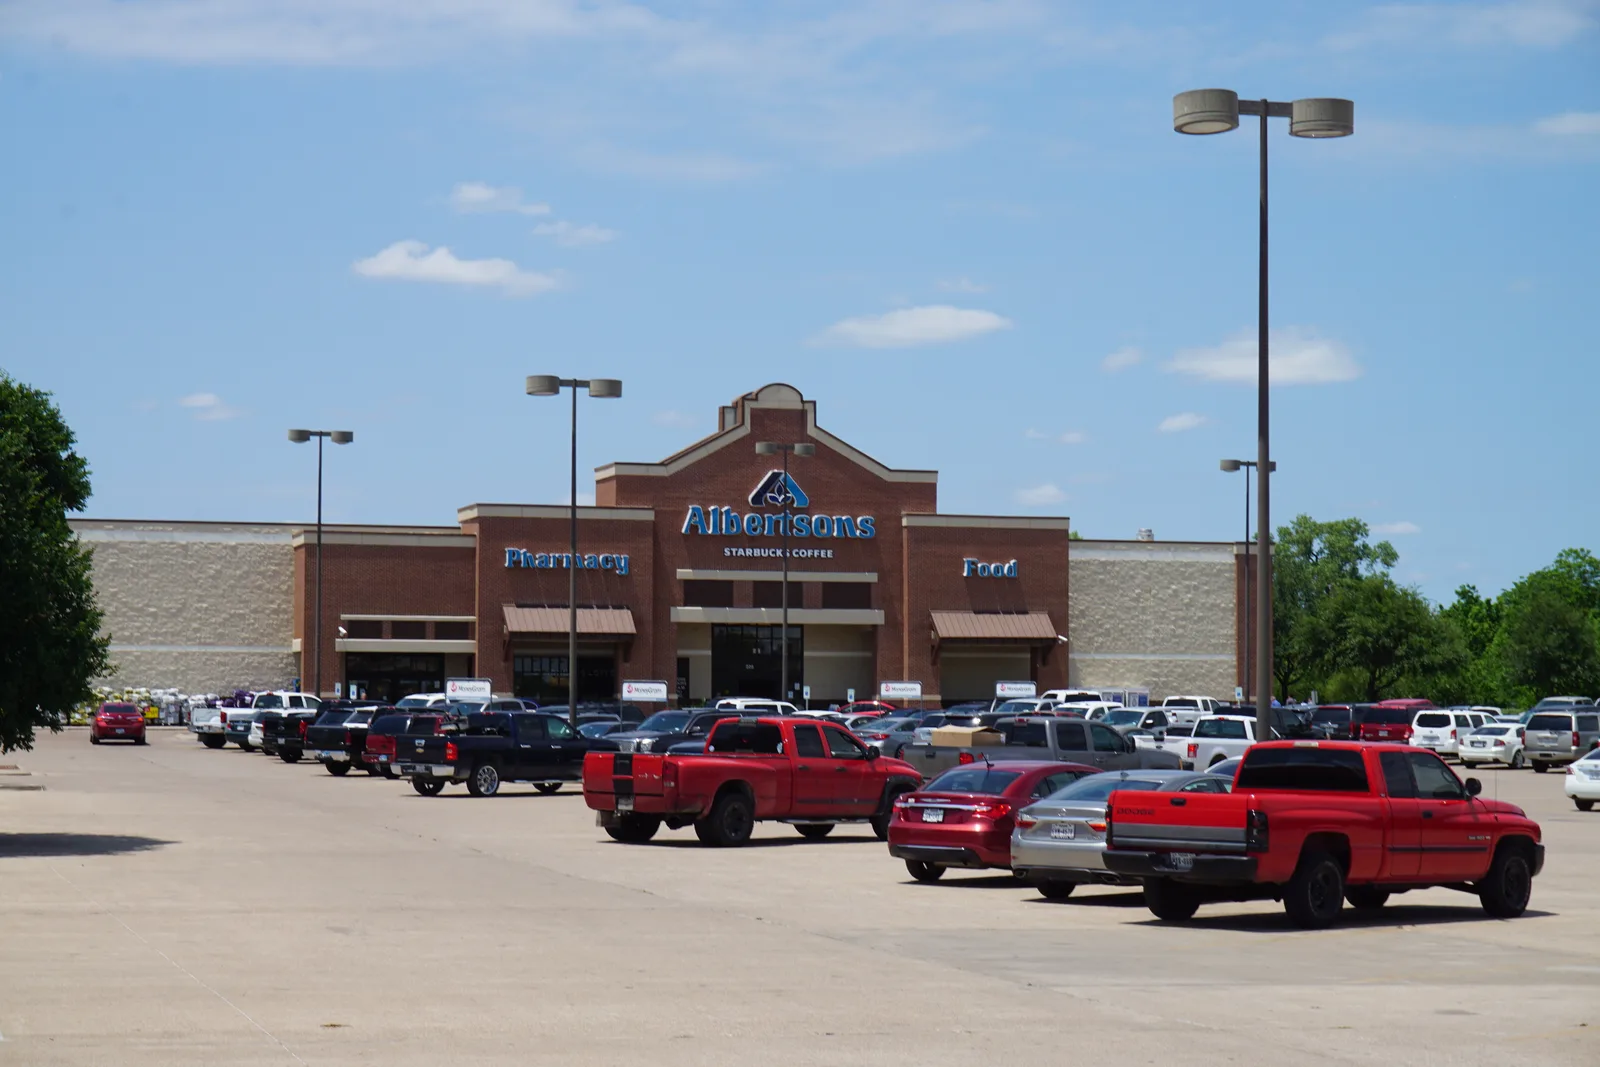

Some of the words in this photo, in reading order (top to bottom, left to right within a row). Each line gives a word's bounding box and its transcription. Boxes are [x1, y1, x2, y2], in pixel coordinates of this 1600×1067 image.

[681, 504, 876, 539] Albertsons
[504, 547, 630, 575] Pharmacy
[792, 549, 834, 558] COFFEE
[962, 557, 1018, 578] Food
